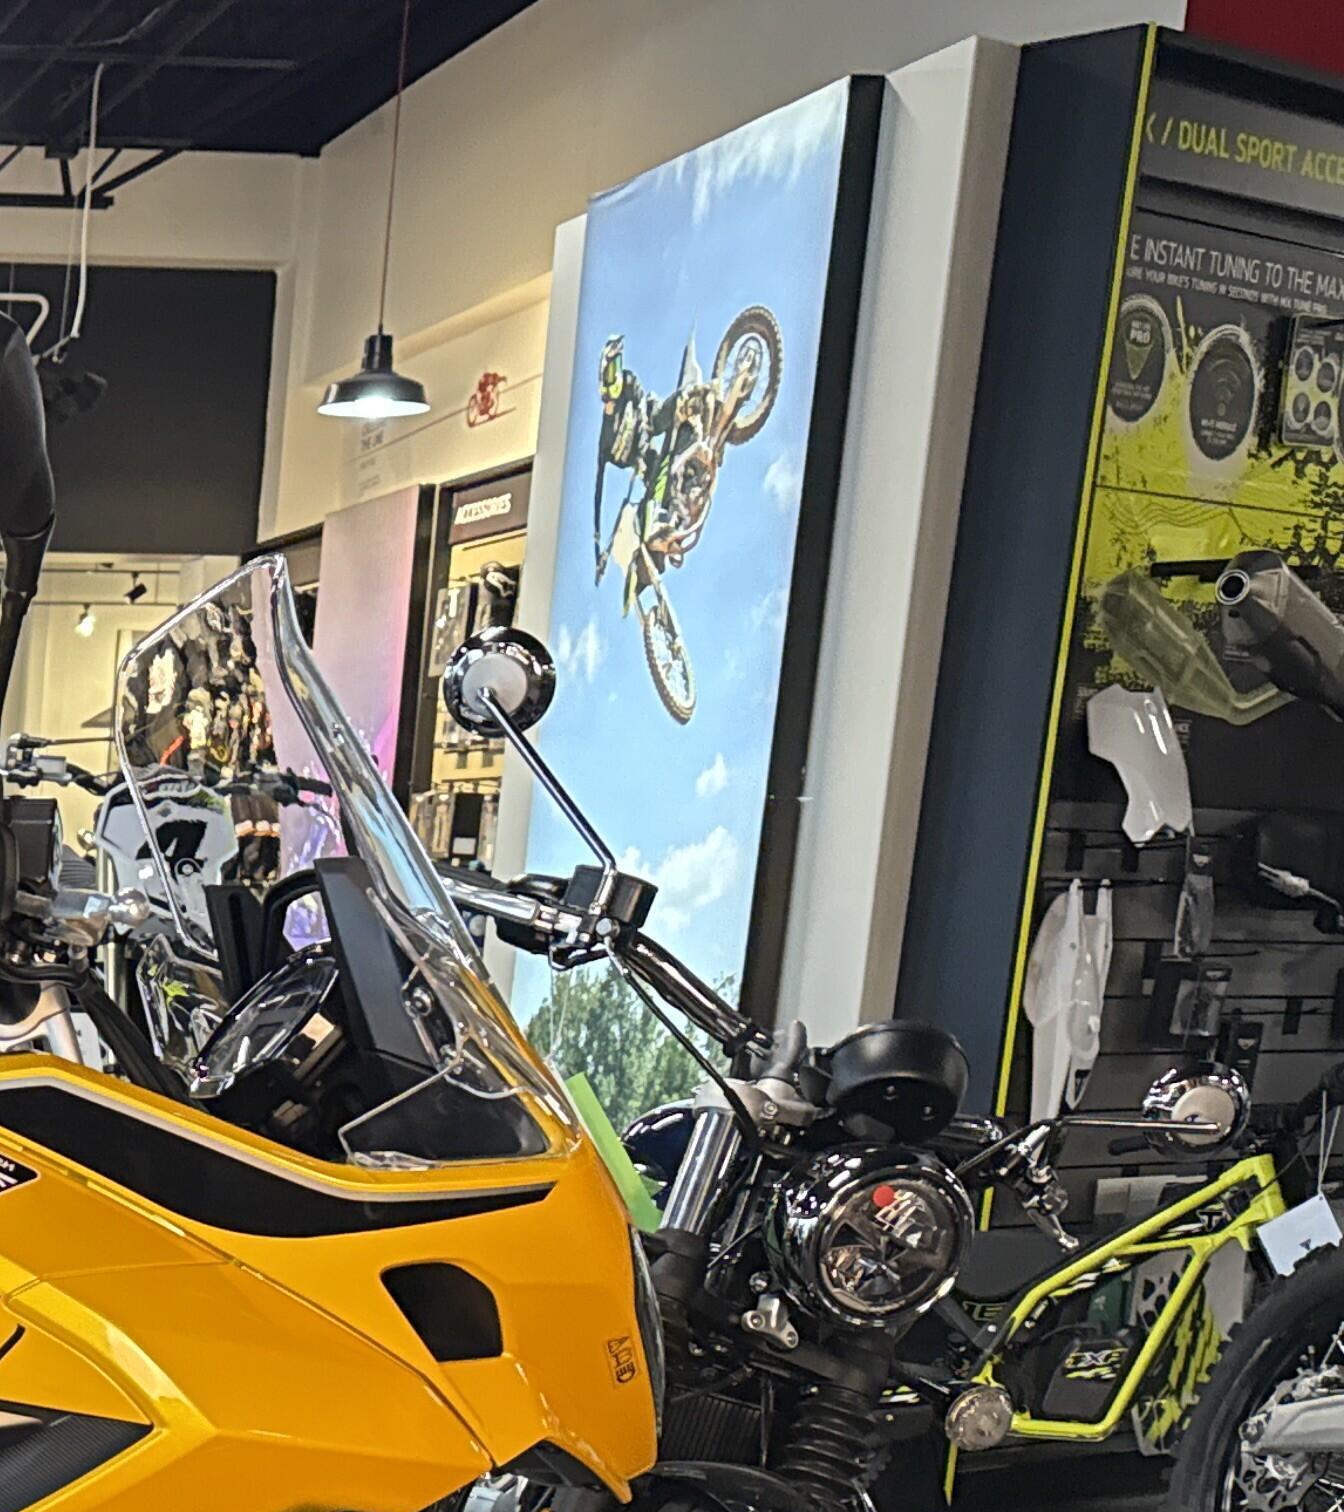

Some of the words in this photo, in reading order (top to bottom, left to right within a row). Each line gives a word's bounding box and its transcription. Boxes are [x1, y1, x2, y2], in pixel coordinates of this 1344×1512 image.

[1177, 119, 1230, 159] DUAL
[1234, 132, 1298, 174] SPORT
[1144, 237, 1207, 272] INSTANT
[1209, 250, 1261, 285] TUNING
[1264, 262, 1284, 289] TO
[1287, 267, 1315, 295] THE
